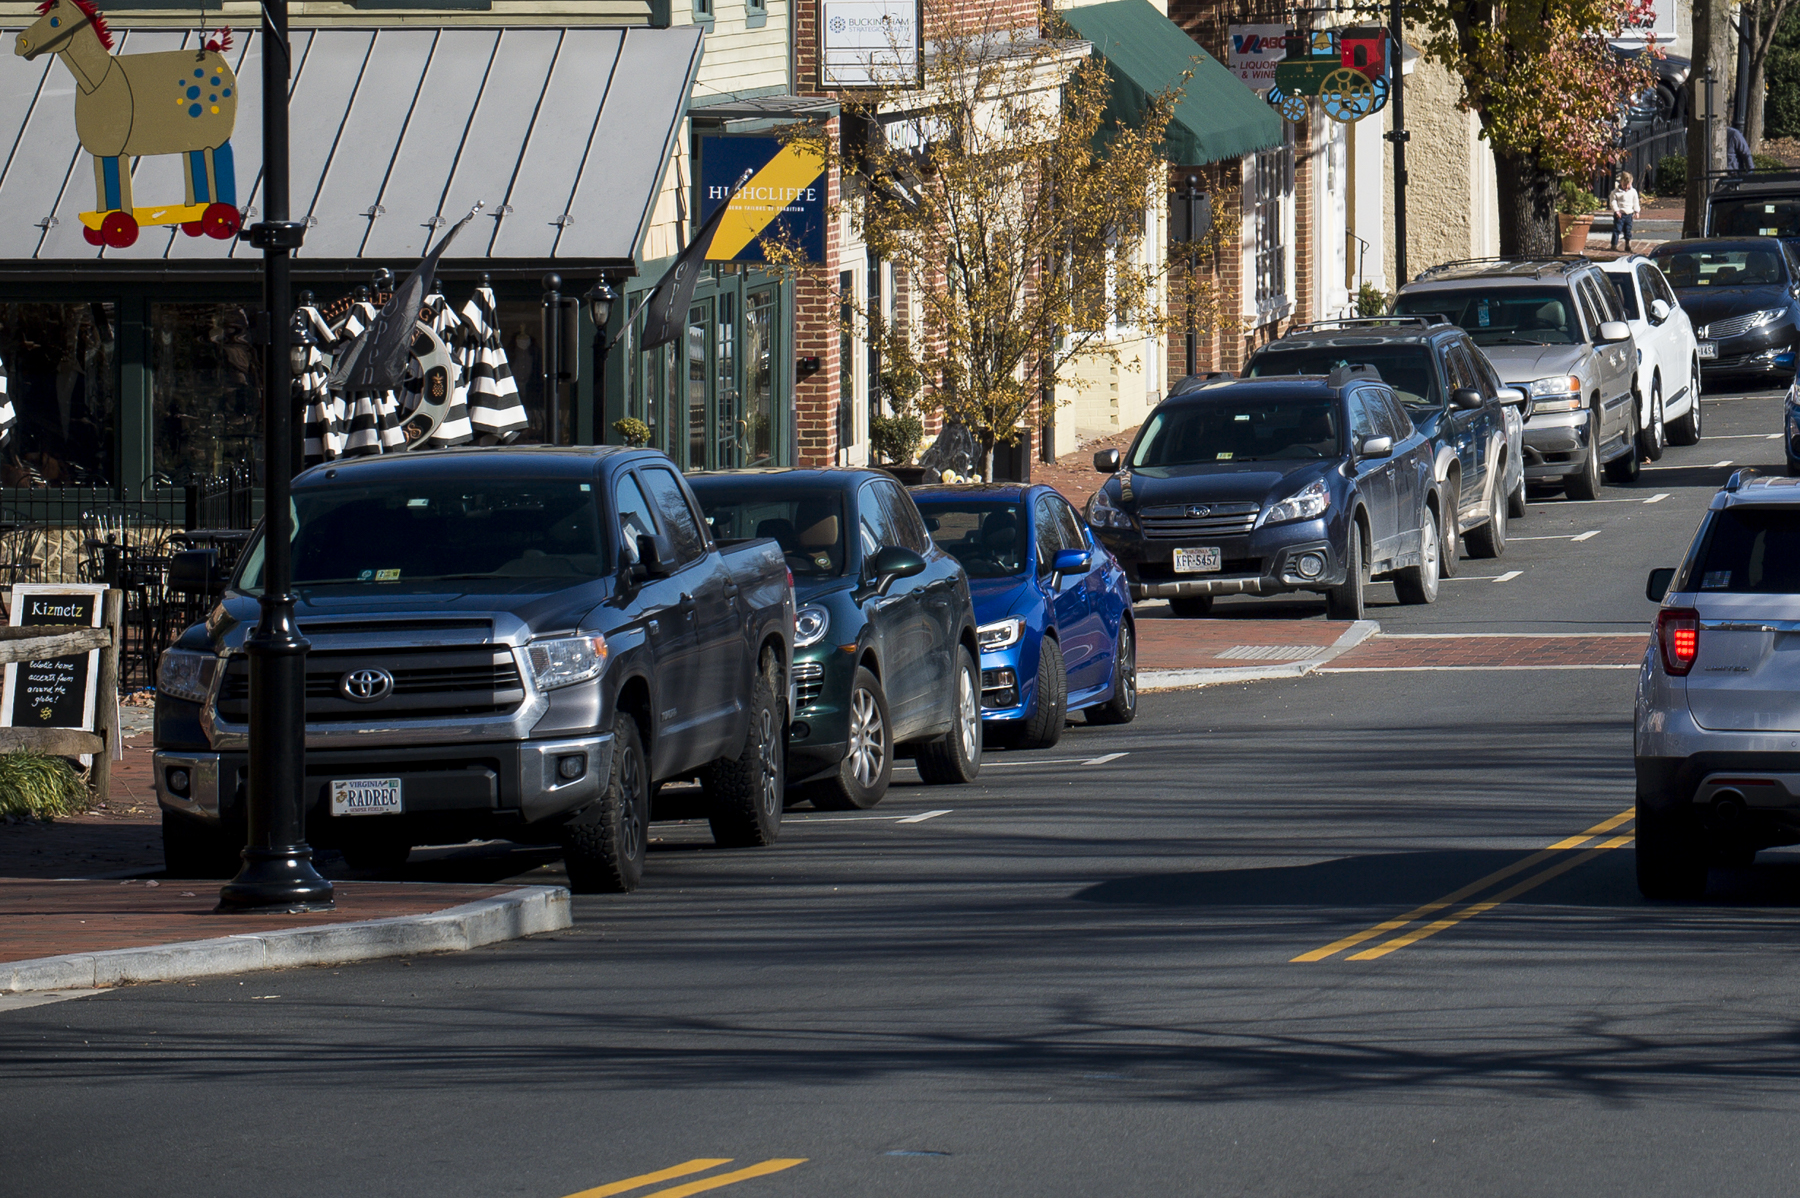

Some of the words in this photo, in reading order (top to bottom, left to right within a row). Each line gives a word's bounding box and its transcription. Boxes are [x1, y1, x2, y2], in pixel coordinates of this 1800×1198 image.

[1257, 36, 1287, 50] ABC
[1241, 70, 1249, 79] &
[31, 601, 84, 618] Kizmetz
[27, 686, 54, 694] around
[348, 780, 384, 788] VIRGINIA
[348, 788, 398, 807] RADREC
